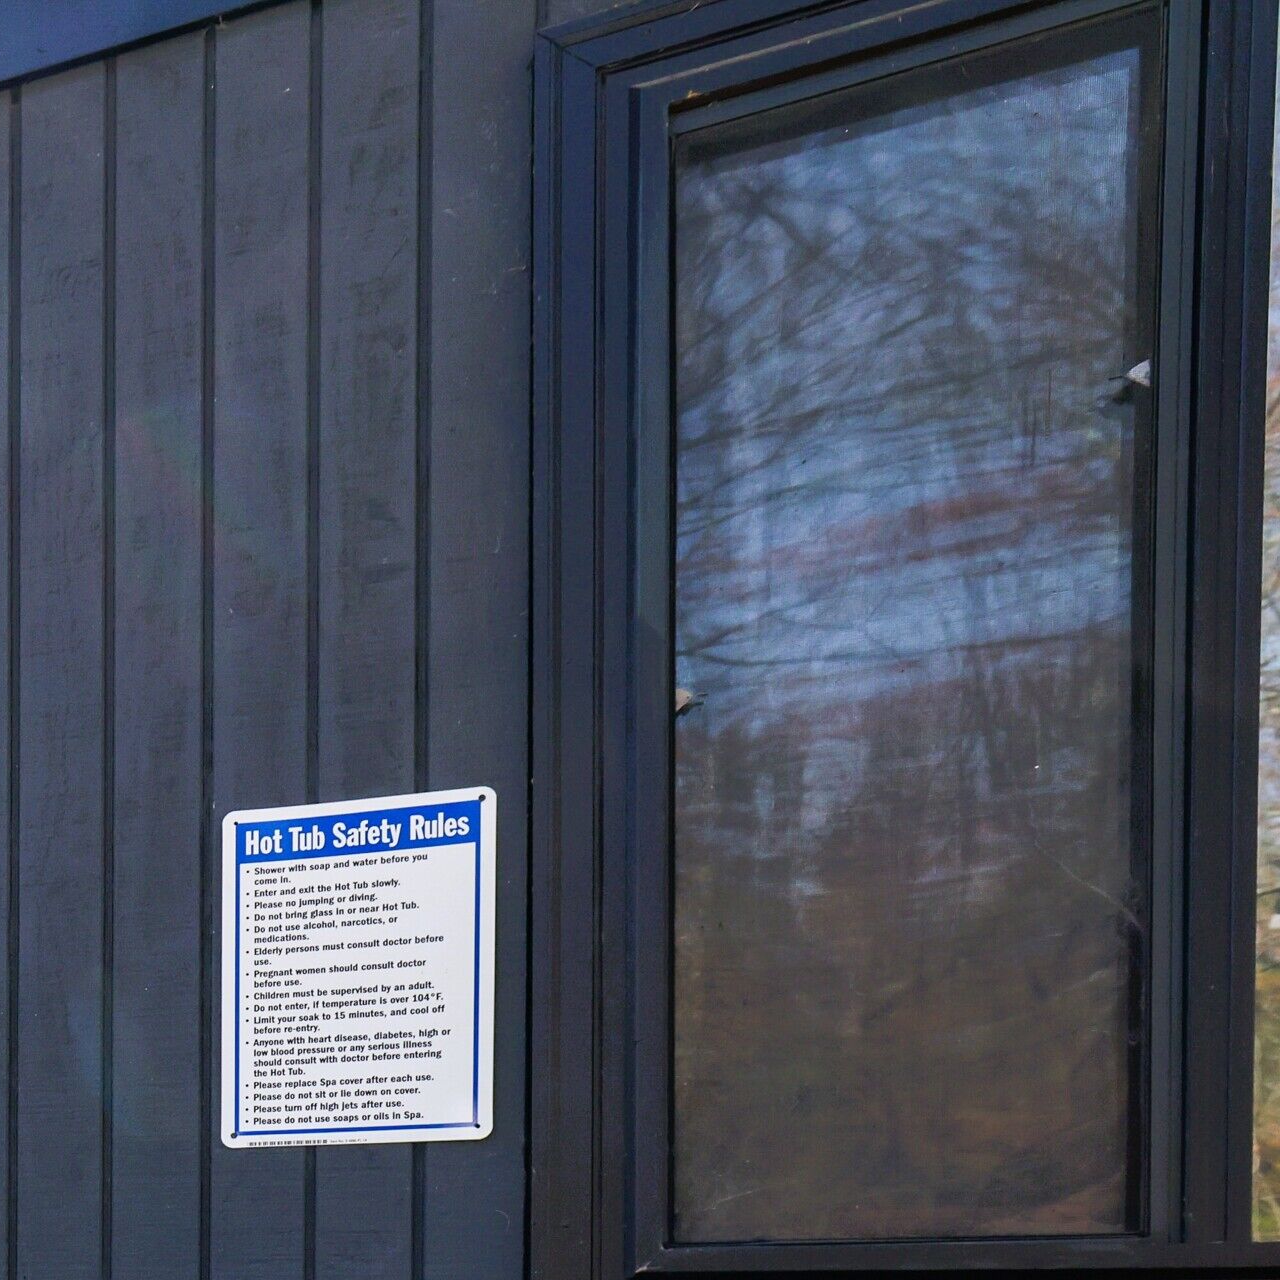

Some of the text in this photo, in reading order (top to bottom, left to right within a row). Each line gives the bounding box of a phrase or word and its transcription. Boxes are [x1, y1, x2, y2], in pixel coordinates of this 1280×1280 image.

[245, 811, 470, 856] Hot Tub Safety Rules
[254, 853, 428, 875] Shower with soap and water before you
[254, 877, 277, 885] come
[254, 878, 400, 898] Enter and exit the Hot Tub slowly.
[254, 901, 283, 909] Please
[298, 896, 334, 908] jumping
[348, 893, 378, 902] diving.
[254, 913, 265, 921] Do
[268, 912, 282, 920] not
[285, 910, 308, 919] bring
[310, 909, 333, 919] glass
[335, 907, 344, 915] in
[359, 905, 380, 913] near
[382, 902, 398, 911] Hot
[400, 901, 419, 910] Tub.
[254, 925, 265, 933] Do
[268, 924, 282, 932] not
[303, 920, 338, 930] alcohol,
[340, 917, 385, 927] narcotics,
[253, 934, 444, 956] Elderly persons must consult doctor before
[254, 933, 309, 944] medications.
[253, 959, 426, 979] Pregnant women should consult doctor
[253, 979, 281, 988] before
[253, 991, 290, 1000] Children
[292, 989, 314, 998] must
[316, 988, 328, 996] be
[330, 984, 378, 996] supervised
[380, 984, 391, 994] by
[408, 981, 434, 990] adult.
[253, 1004, 265, 1012] Do
[267, 1003, 282, 1011] not
[284, 1002, 310, 1010] enter,
[312, 1000, 319, 1009] if
[321, 998, 376, 1009] temperature
[379, 996, 387, 1004] is
[389, 996, 409, 1004] over
[253, 1004, 445, 1025] Limit your soak to 15 minutes, and cool off
[253, 1024, 320, 1034] before re-entry.
[252, 1028, 451, 1048] Anyone with heart disease, diabetes, high or
[253, 1049, 268, 1057] low
[270, 1047, 295, 1056] blood
[297, 1046, 335, 1056] pressure
[349, 1045, 365, 1053] any
[367, 1041, 400, 1051] serious
[402, 1040, 432, 1049] illness
[253, 1049, 442, 1067] should consult with doctor before entering
[253, 1067, 306, 1077] the Hot Tub.
[253, 1081, 282, 1089] Please
[284, 1079, 317, 1089] replace
[319, 1077, 337, 1087] Spa
[365, 1075, 388, 1084] after
[390, 1073, 412, 1083] each
[253, 1093, 282, 1101] Please
[284, 1092, 295, 1100] do
[298, 1091, 312, 1099] not
[315, 1090, 326, 1099] sit
[340, 1089, 352, 1097] lie
[354, 1088, 377, 1097] down
[380, 1088, 391, 1096] on
[394, 1087, 421, 1095] cover.
[253, 1100, 404, 1113] Please turn off high jets after use.
[253, 1117, 282, 1125] Please
[284, 1116, 295, 1124] do
[297, 1115, 312, 1123] not
[332, 1114, 359, 1123] soaps
[373, 1112, 390, 1120] oils
[392, 1111, 401, 1120] in
[403, 1110, 424, 1120] Spa.
